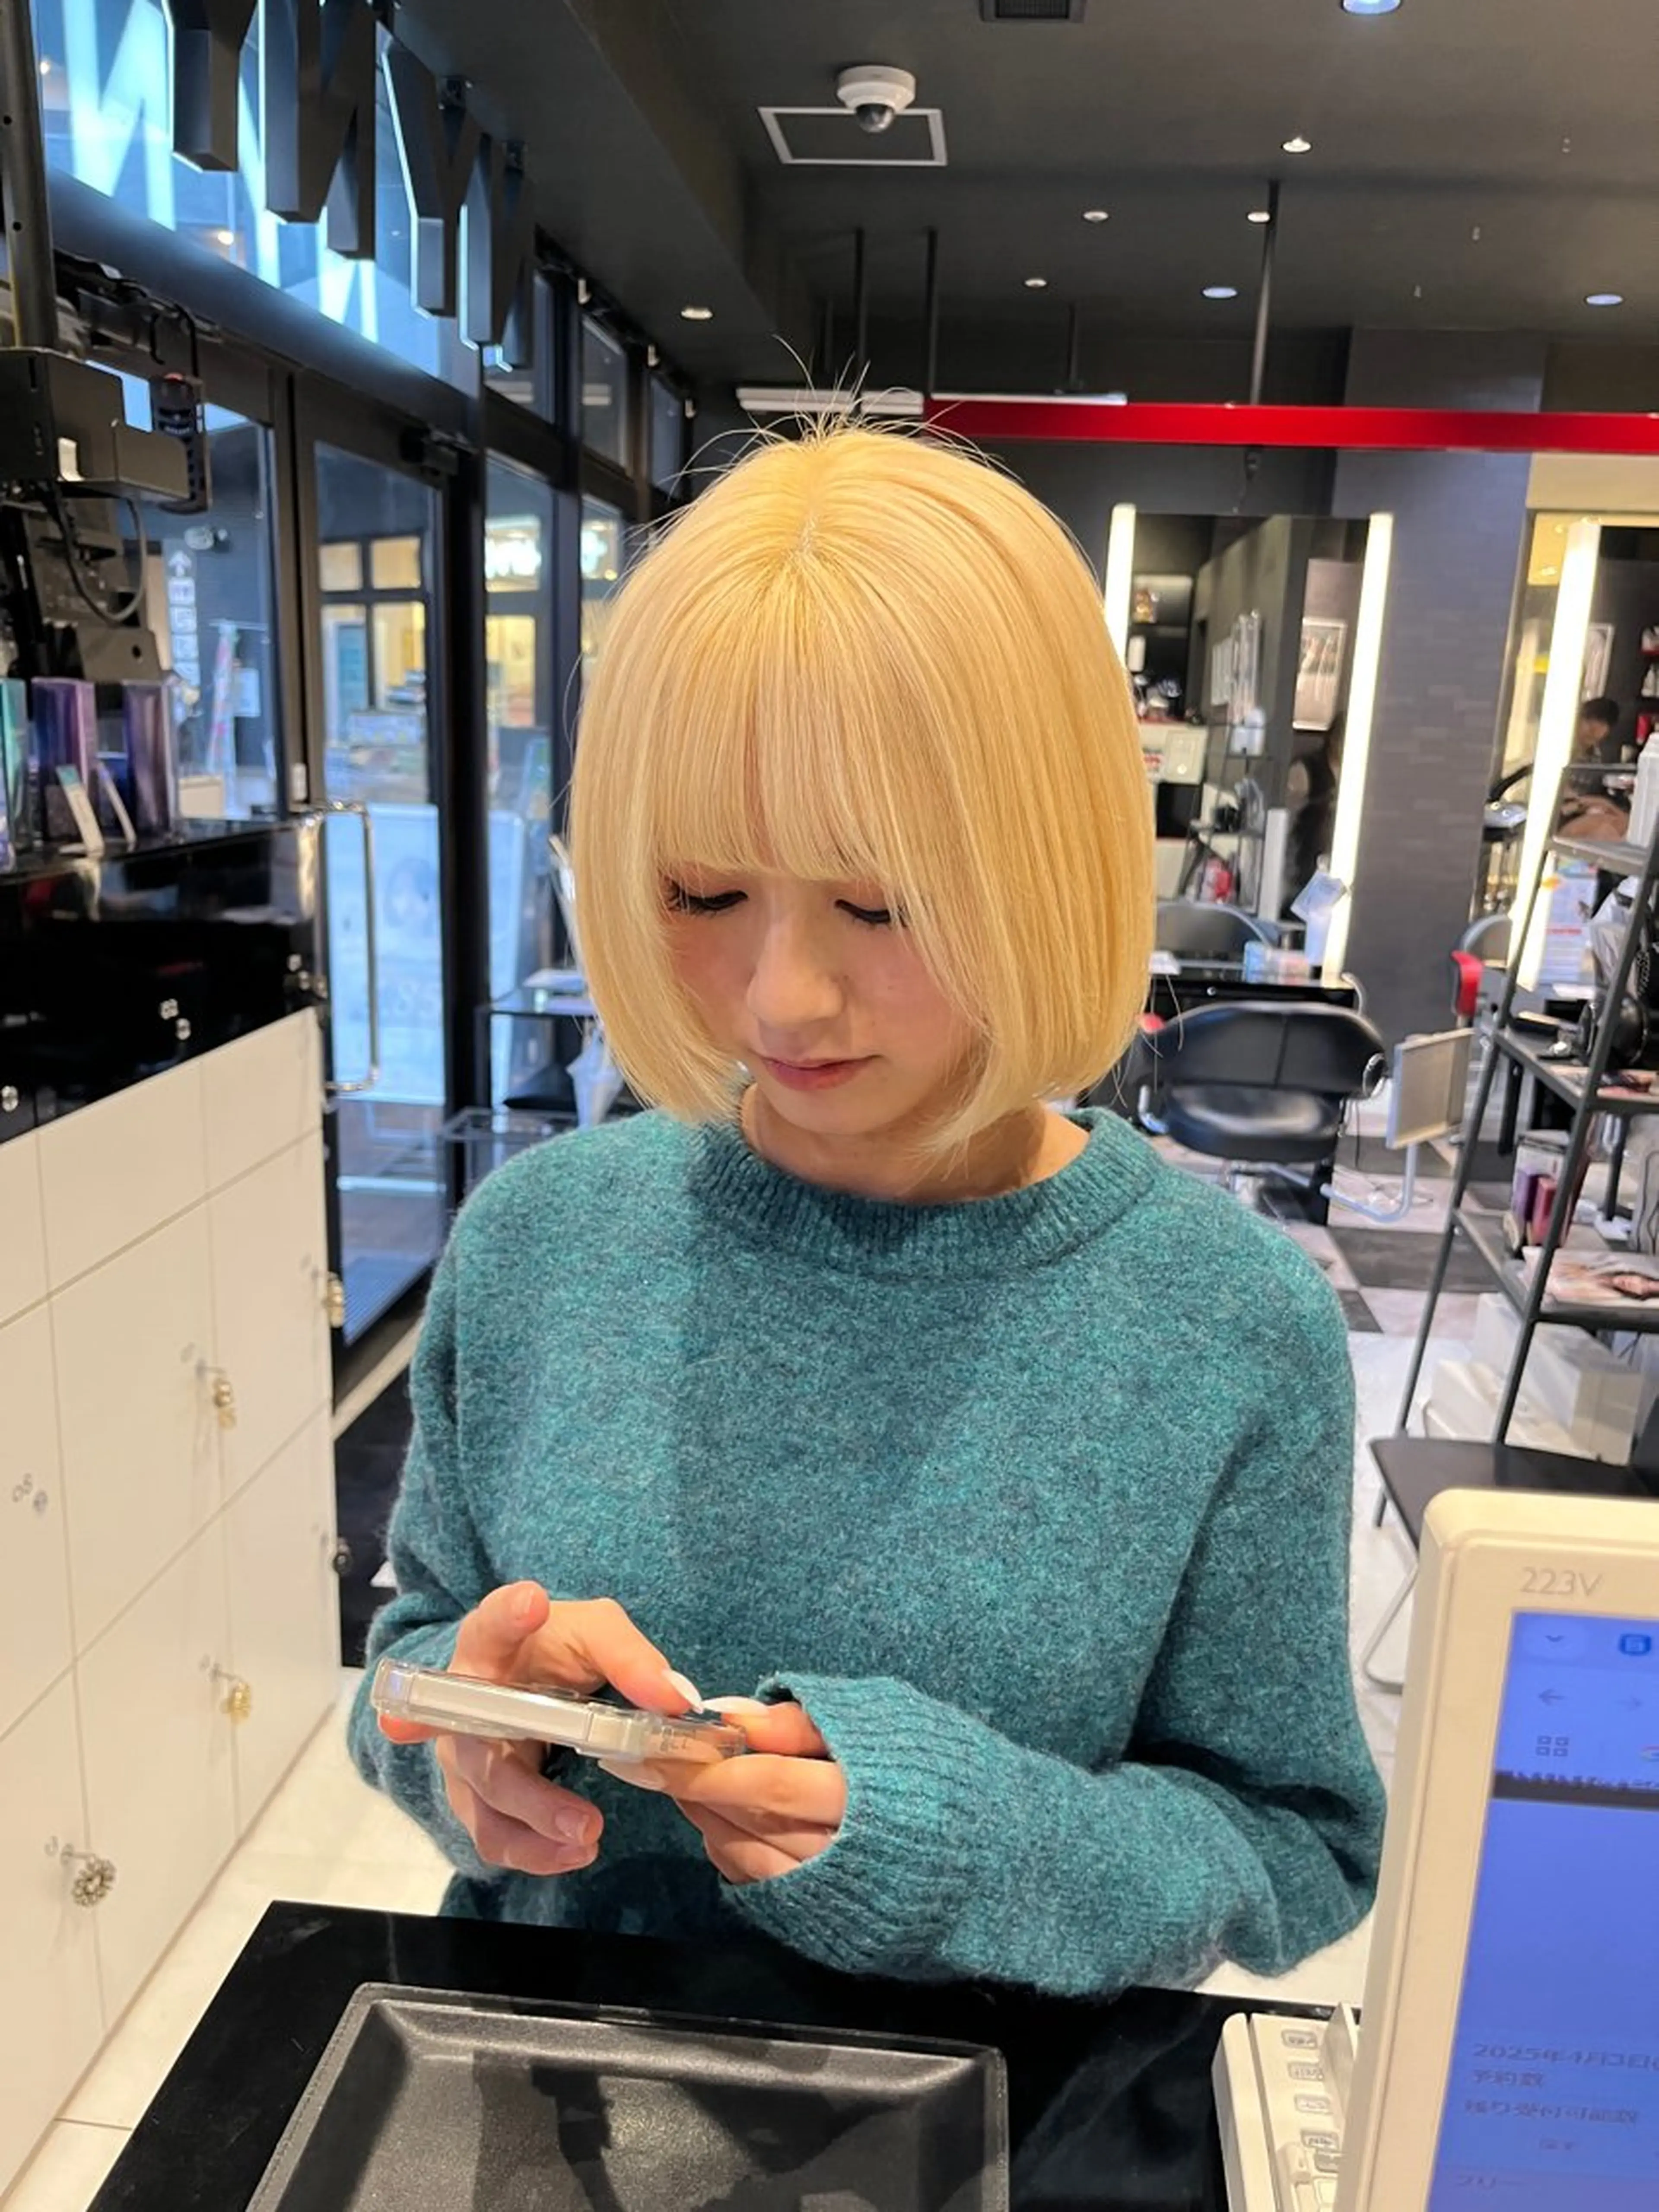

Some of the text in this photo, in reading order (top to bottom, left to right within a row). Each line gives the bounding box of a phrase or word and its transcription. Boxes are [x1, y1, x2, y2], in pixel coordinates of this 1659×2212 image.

[1521, 1567, 1603, 1596] 223V
[1472, 2044, 1659, 2070] 2025年4月3日
